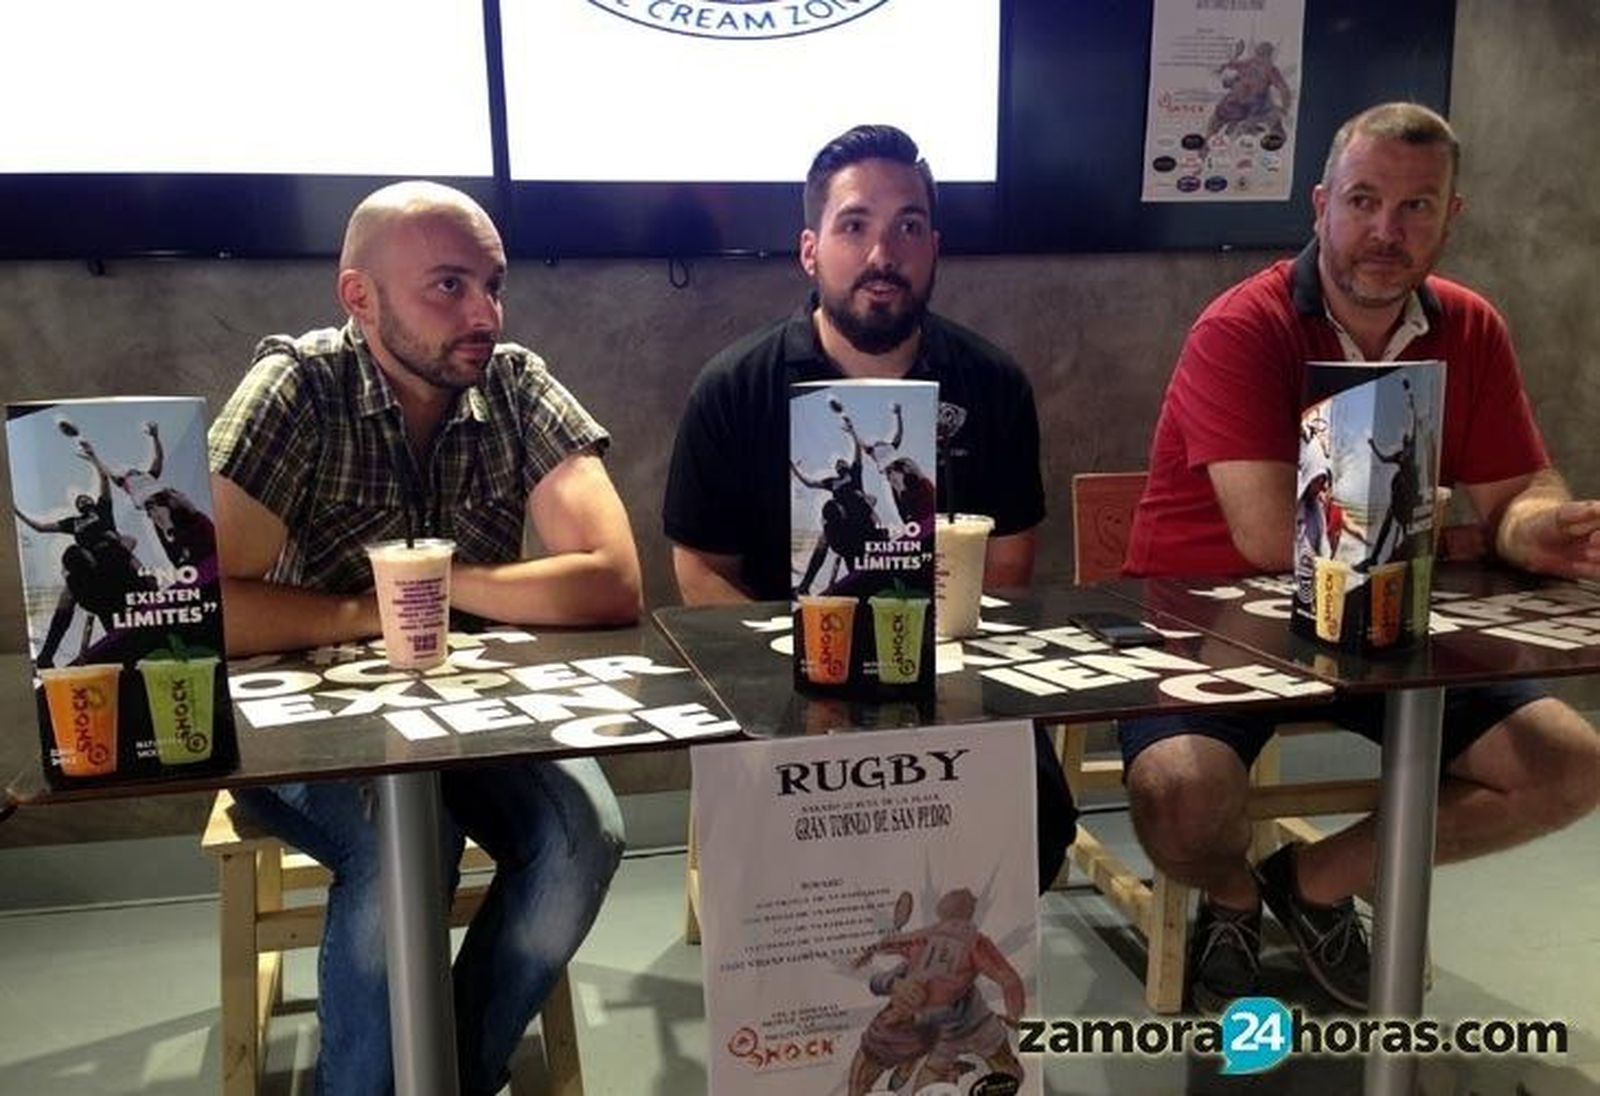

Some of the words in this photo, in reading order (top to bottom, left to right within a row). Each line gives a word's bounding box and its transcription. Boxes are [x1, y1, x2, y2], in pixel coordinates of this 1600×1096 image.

[648, 0, 777, 31] CREAM
[865, 540, 921, 552] EXISTEN
[125, 588, 200, 606] EXISTEN
[551, 703, 742, 748] CE
[775, 749, 971, 796] RUGBY
[795, 815, 827, 841] GRAN
[873, 809, 888, 833] DE
[891, 806, 915, 831] SAN
